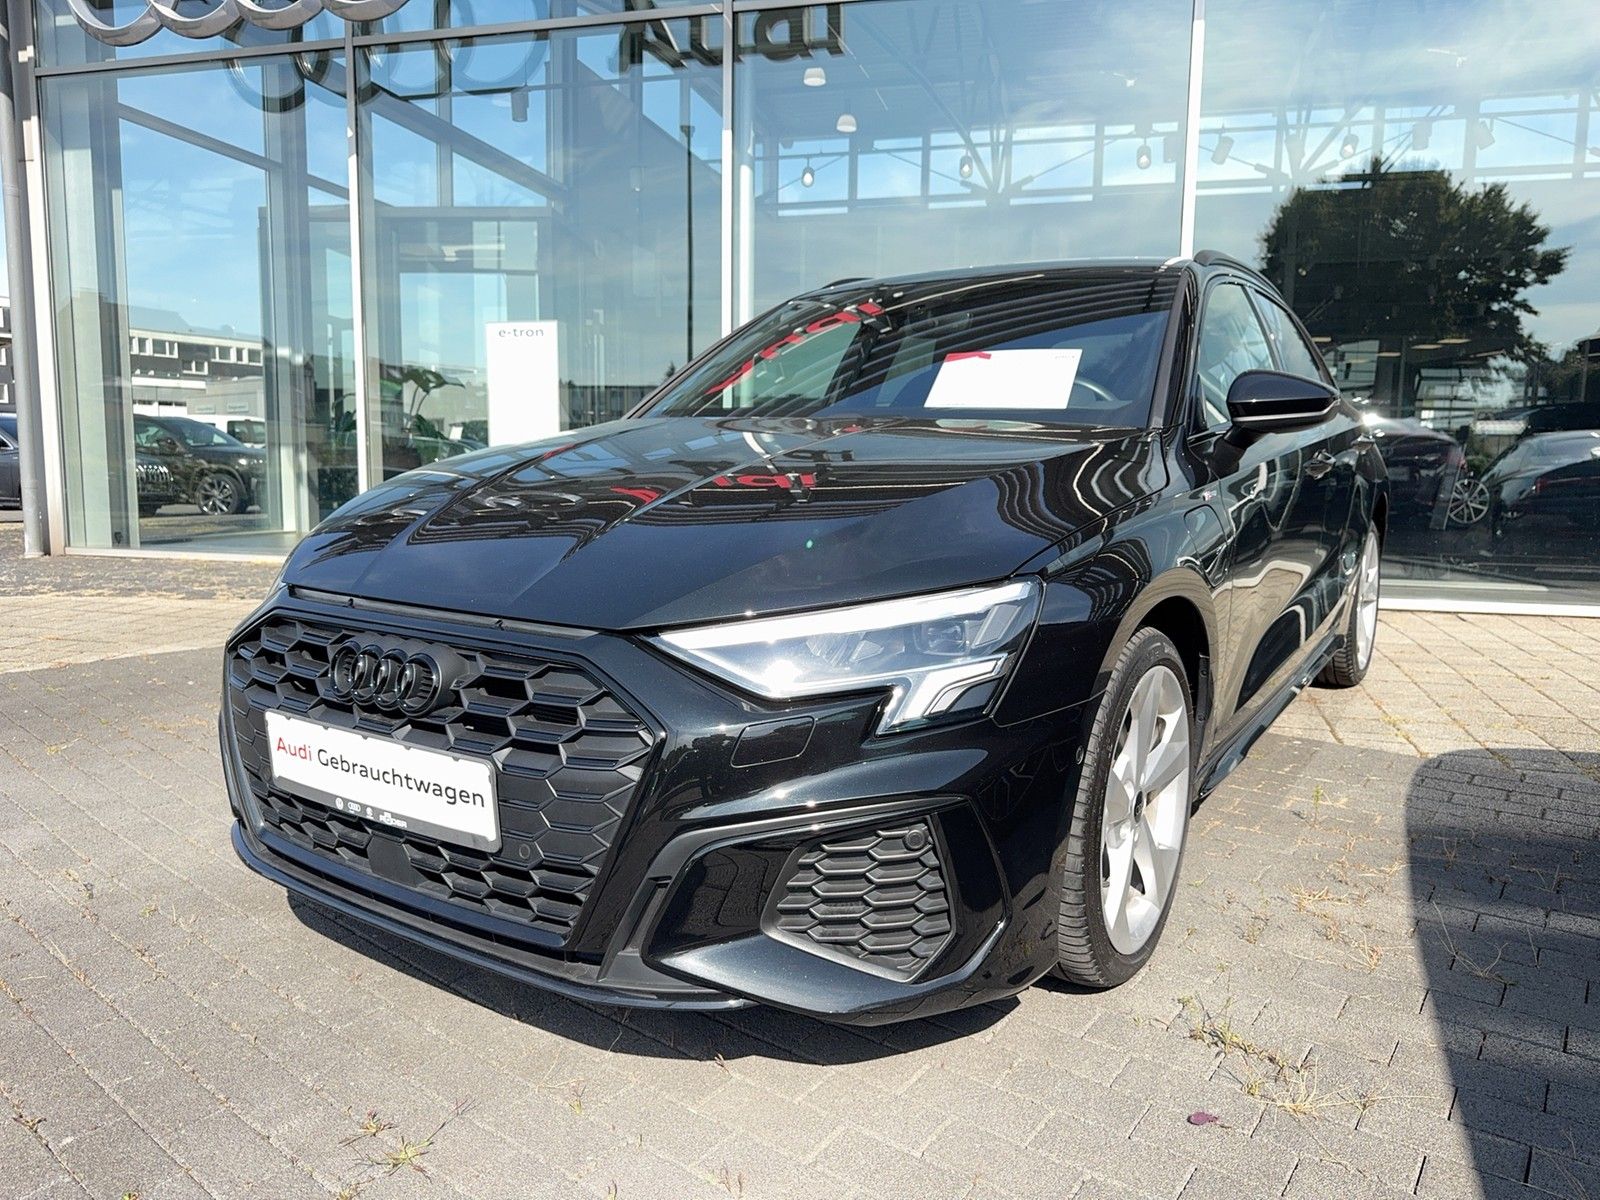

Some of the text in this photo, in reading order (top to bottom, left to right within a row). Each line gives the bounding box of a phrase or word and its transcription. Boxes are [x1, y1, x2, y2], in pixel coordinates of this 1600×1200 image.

[498, 328, 544, 337] e-tron
[276, 737, 485, 807] Audi Gebrauchtwagen
